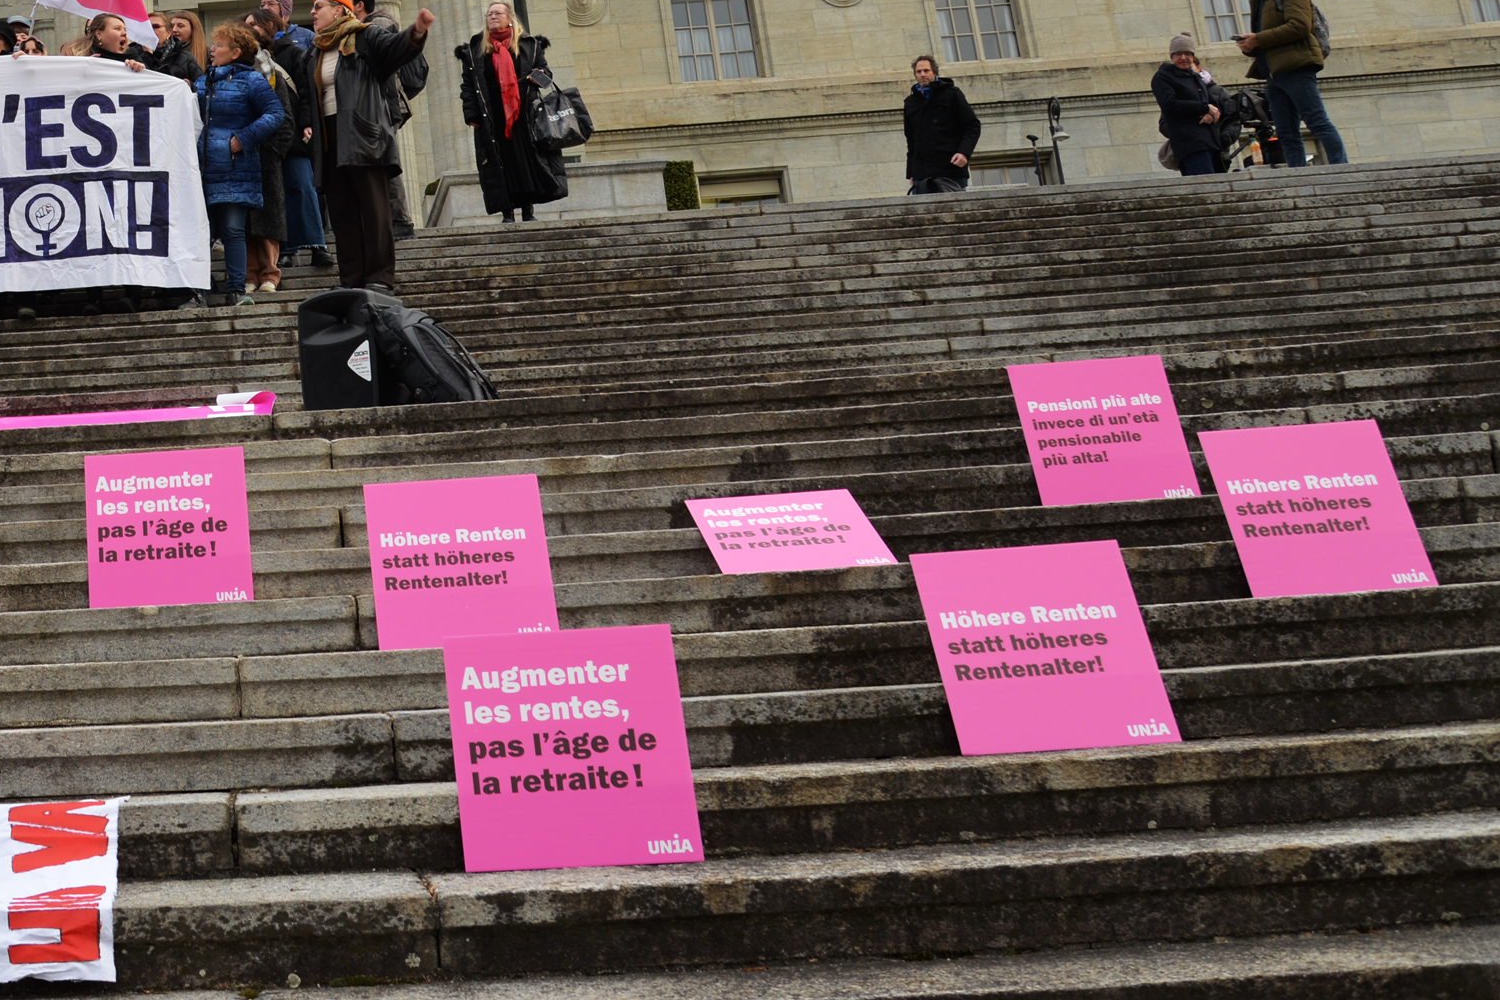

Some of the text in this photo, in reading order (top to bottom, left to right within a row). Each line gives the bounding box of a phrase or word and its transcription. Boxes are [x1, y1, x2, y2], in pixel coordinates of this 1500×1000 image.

[1027, 392, 1162, 414] Pensioni più alte
[1032, 418, 1085, 431] invece
[1089, 414, 1105, 427] di
[1037, 430, 1142, 451] pensionabile
[1042, 450, 1110, 469] più alta!
[95, 471, 213, 494] Augmenter
[1226, 472, 1379, 495] Höhere Renten
[96, 495, 211, 516] les rentes,
[703, 501, 824, 518] Augmenter
[1236, 497, 1373, 517] statt höheres
[97, 524, 137, 543] pas
[201, 516, 228, 533] de
[706, 513, 829, 529] les rentes,
[714, 527, 757, 541] pas
[823, 523, 852, 533] de
[1242, 516, 1371, 539] Rentenalter!
[379, 526, 527, 548] Höhere Renten
[719, 541, 743, 551] la
[98, 546, 118, 563] la
[382, 550, 515, 569] statt höheres
[384, 570, 509, 591] Rentenalter!
[939, 602, 1117, 630] Höhere Renten
[948, 632, 1109, 656] statt höheres
[461, 660, 630, 694] Augmenter
[954, 655, 1106, 682] Rentenalter!
[464, 695, 630, 725] les rentes,
[468, 738, 525, 765] pas
[618, 728, 658, 752] de
[472, 771, 501, 796] la
